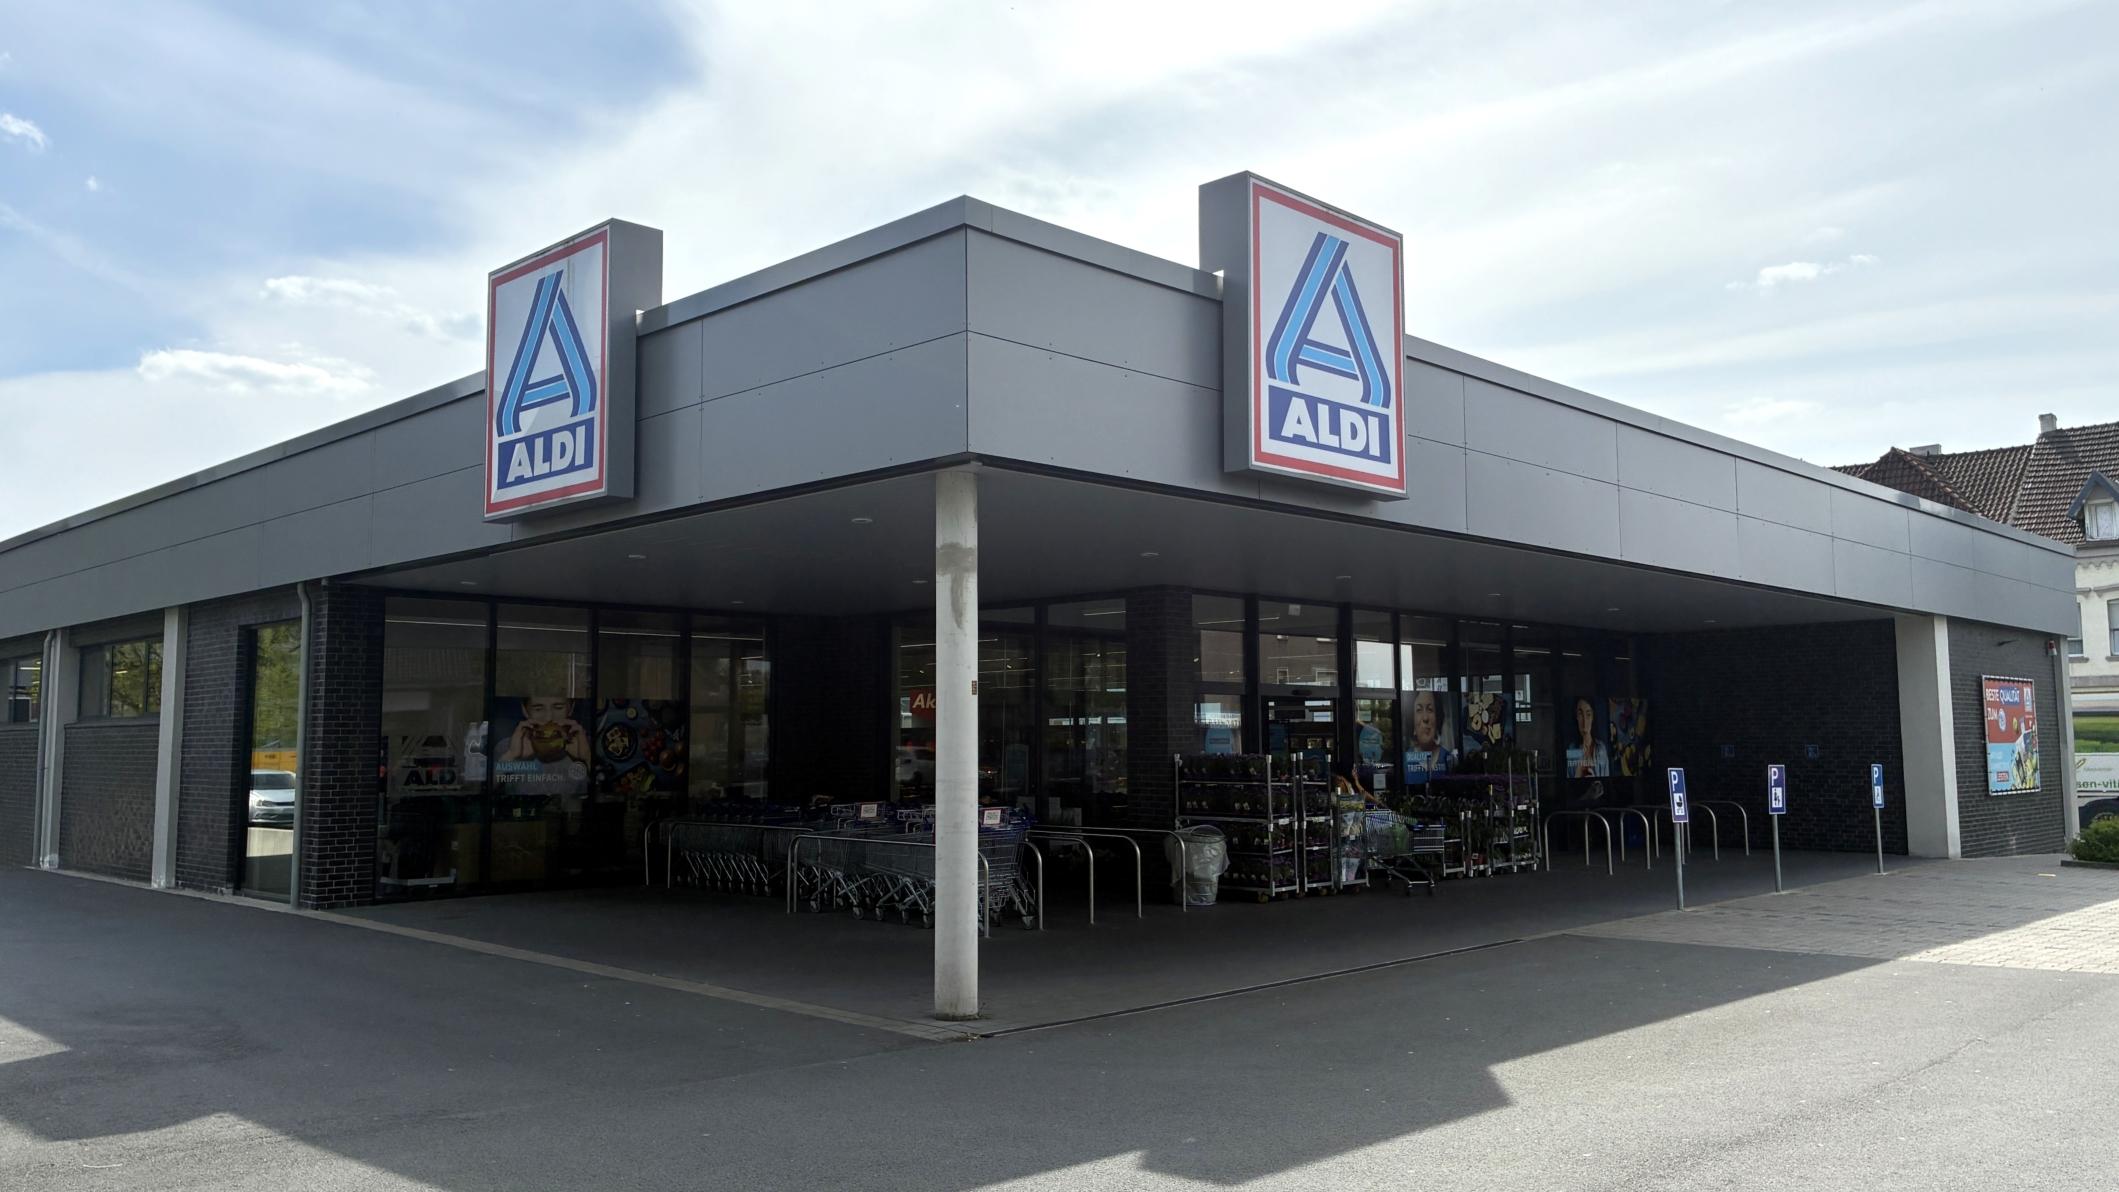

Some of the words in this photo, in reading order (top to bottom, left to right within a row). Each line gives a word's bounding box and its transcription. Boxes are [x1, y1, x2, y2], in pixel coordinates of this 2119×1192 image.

[1280, 396, 1380, 457] ALDI
[506, 425, 586, 483] ALDI
[495, 761, 538, 770] AUSWAHL
[1873, 766, 1880, 784] P
[495, 774, 525, 784] TRIFFT
[1670, 771, 1679, 792] P
[1771, 767, 1779, 787] P
